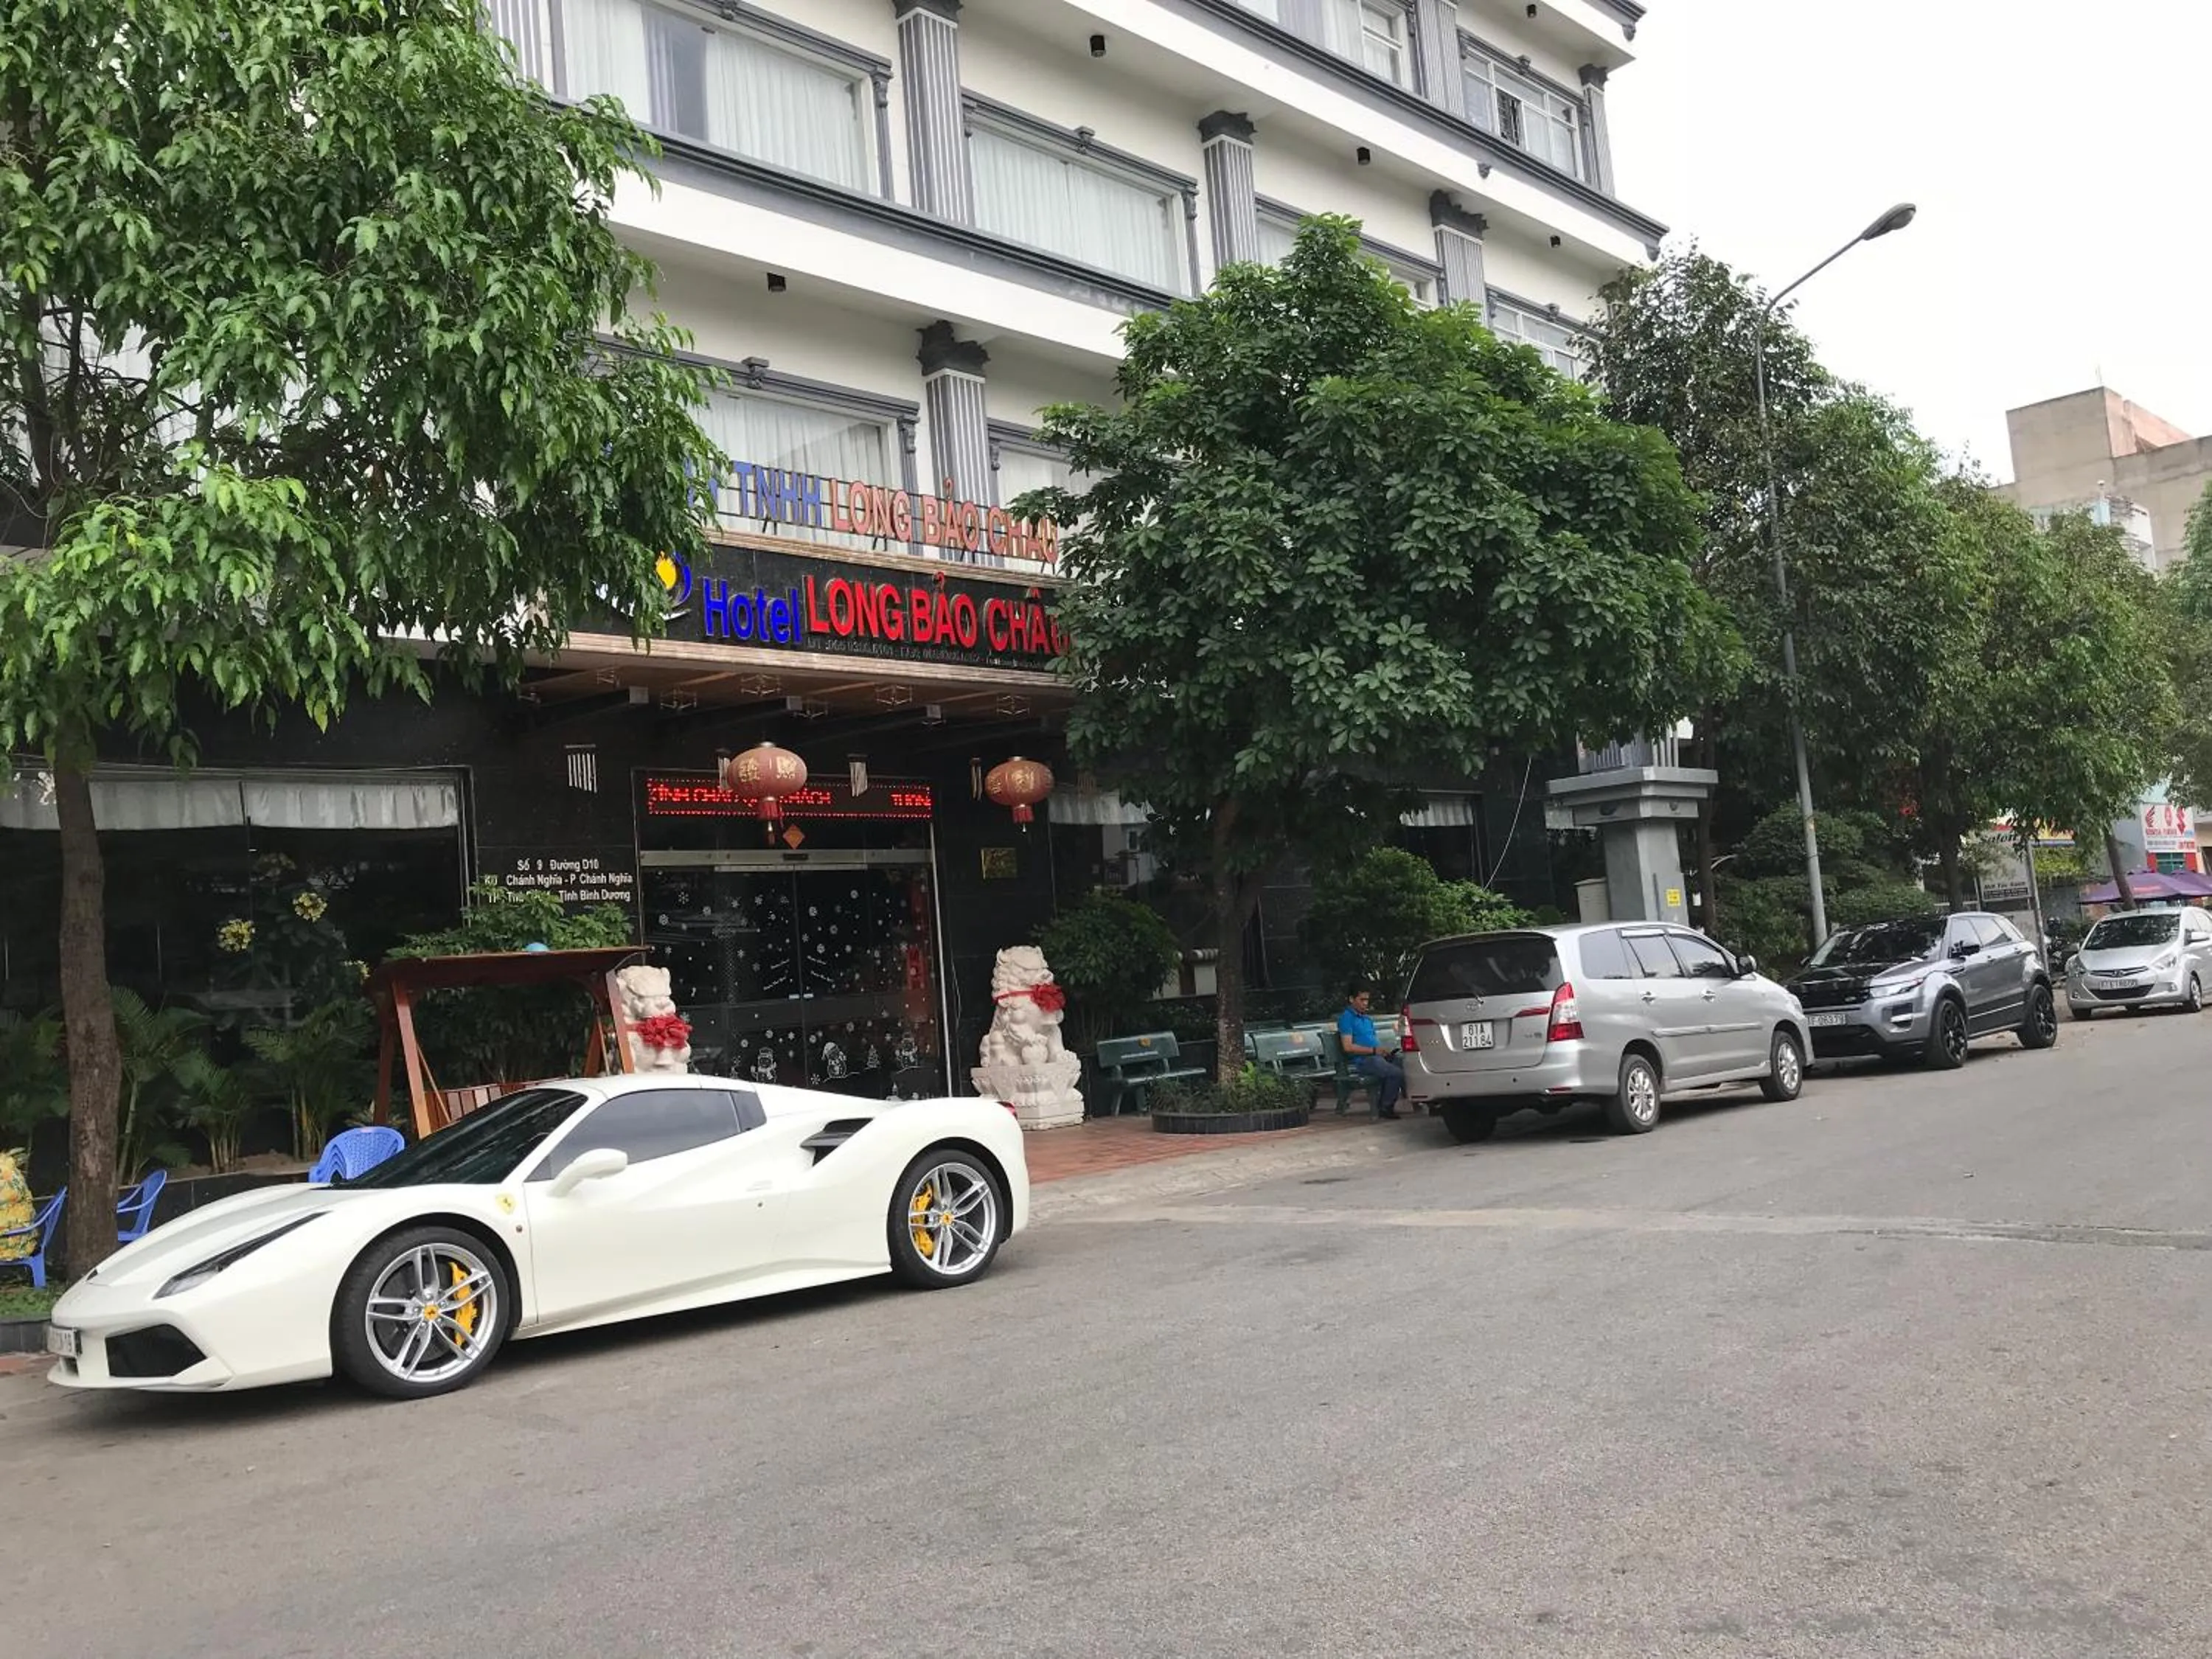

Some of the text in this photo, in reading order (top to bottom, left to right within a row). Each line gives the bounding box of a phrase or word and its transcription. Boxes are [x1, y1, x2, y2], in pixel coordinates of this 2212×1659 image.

[732, 460, 822, 526] TNHH
[830, 478, 912, 543] LONG
[922, 476, 981, 552] BẢO
[702, 575, 803, 644] Hotel
[804, 574, 904, 641] LONG
[910, 571, 978, 648] BẢO
[517, 858, 599, 872] Số 9 Đường D10
[506, 873, 535, 886] Chánh
[537, 873, 563, 888] Nghĩa
[570, 874, 576, 886] P
[579, 873, 607, 885] Chánh
[608, 872, 633, 886] Nghĩa
[601, 888, 631, 902] Dương
